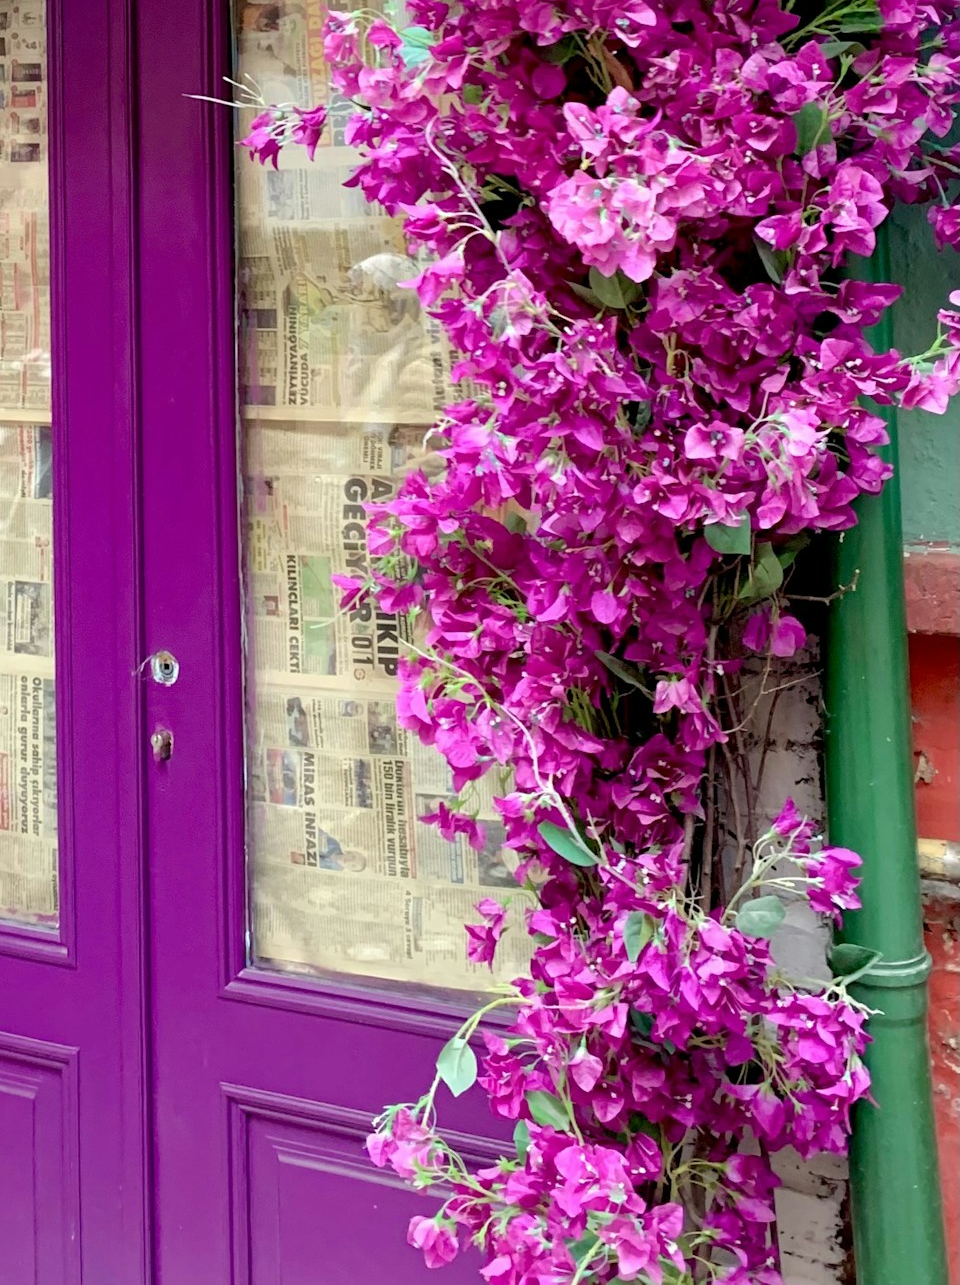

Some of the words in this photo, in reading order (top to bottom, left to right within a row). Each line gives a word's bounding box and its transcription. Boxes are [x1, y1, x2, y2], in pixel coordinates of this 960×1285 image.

[298, 353, 309, 405] VÜCUDA
[342, 477, 372, 624] GEÇİYR
[19, 675, 31, 722] onlarla
[31, 677, 42, 740] Okullarına
[17, 726, 28, 763] gurur
[29, 743, 41, 776] sahip
[383, 759, 394, 780] 150
[18, 766, 31, 834] duyuyoruz
[304, 751, 316, 807] MİRAS
[384, 782, 395, 801] bin
[394, 759, 406, 816] Doktorun
[29, 779, 42, 837] çıkıyorlar
[385, 802, 396, 835] liralık
[305, 811, 318, 868] İNFAZI
[386, 837, 398, 877] vurgun
[397, 819, 410, 878] hesabıyla
